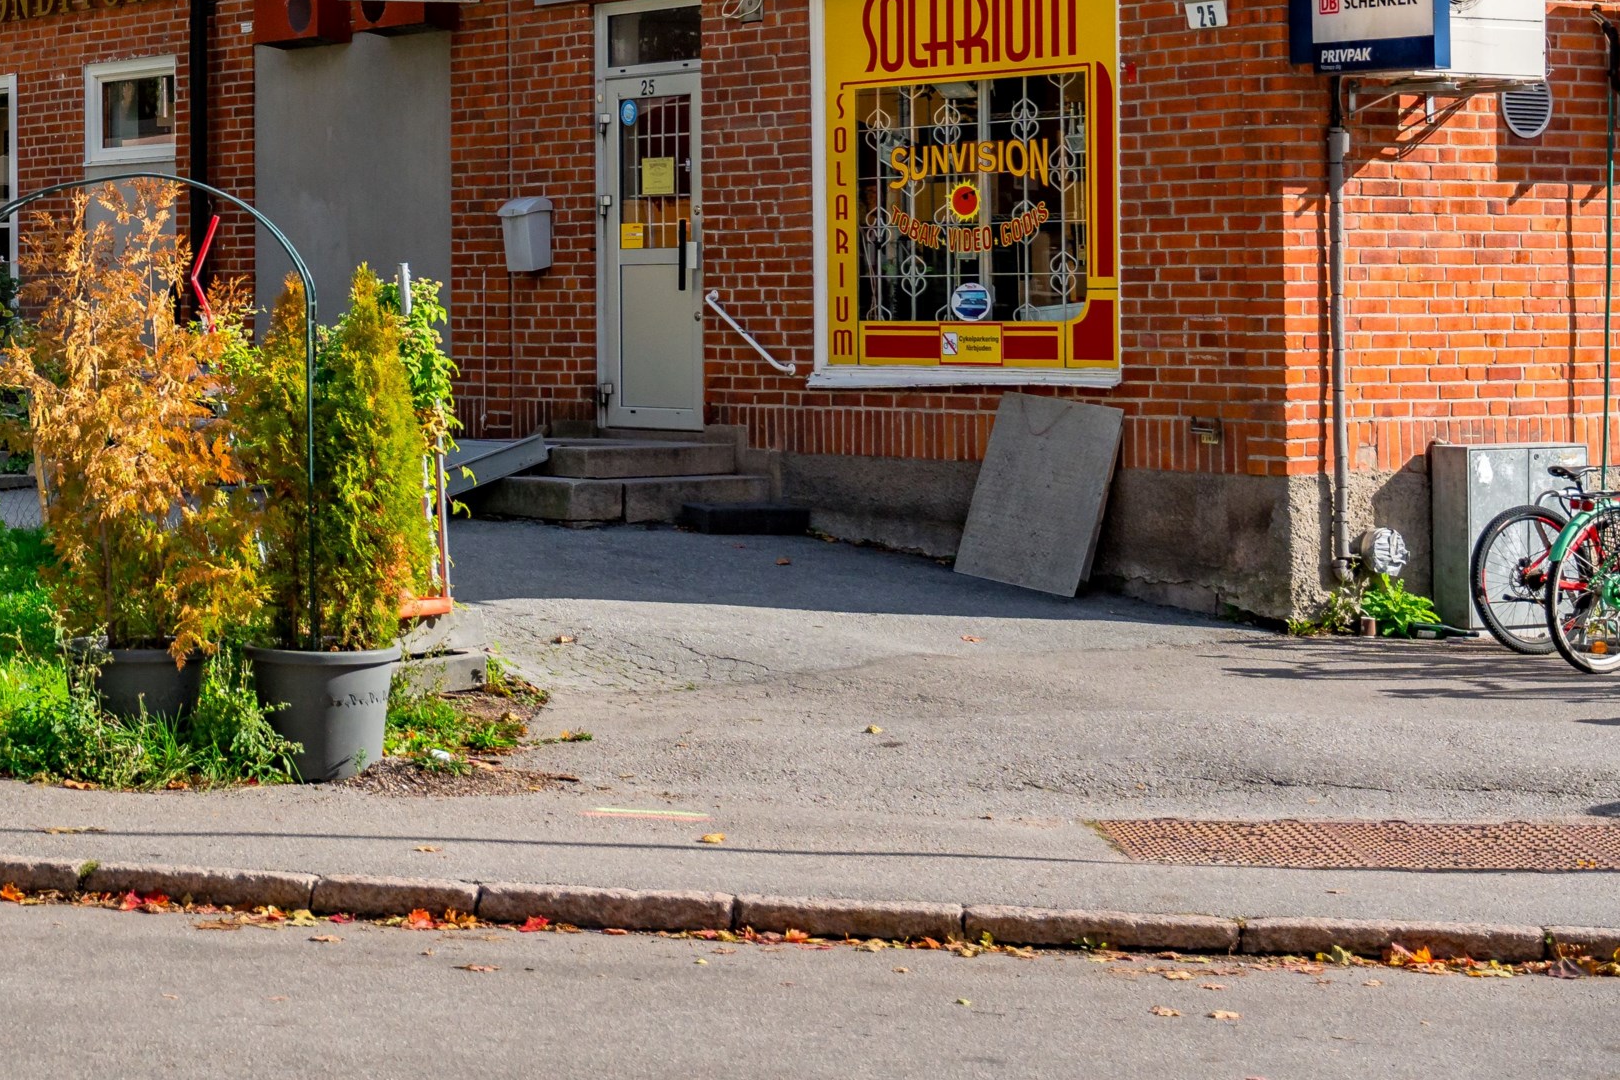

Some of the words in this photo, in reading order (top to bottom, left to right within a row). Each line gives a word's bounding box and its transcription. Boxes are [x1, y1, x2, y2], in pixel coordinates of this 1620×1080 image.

[1197, 4, 1217, 27] 25
[1321, 47, 1371, 63] PRIVPAK
[641, 79, 655, 96] 25
[889, 138, 1048, 189] SUNVISION
[833, 92, 853, 357] SOLARIUM
[890, 204, 942, 250] TOBAK
[948, 225, 992, 252] VIDEO
[1000, 200, 1049, 248] GODIS
